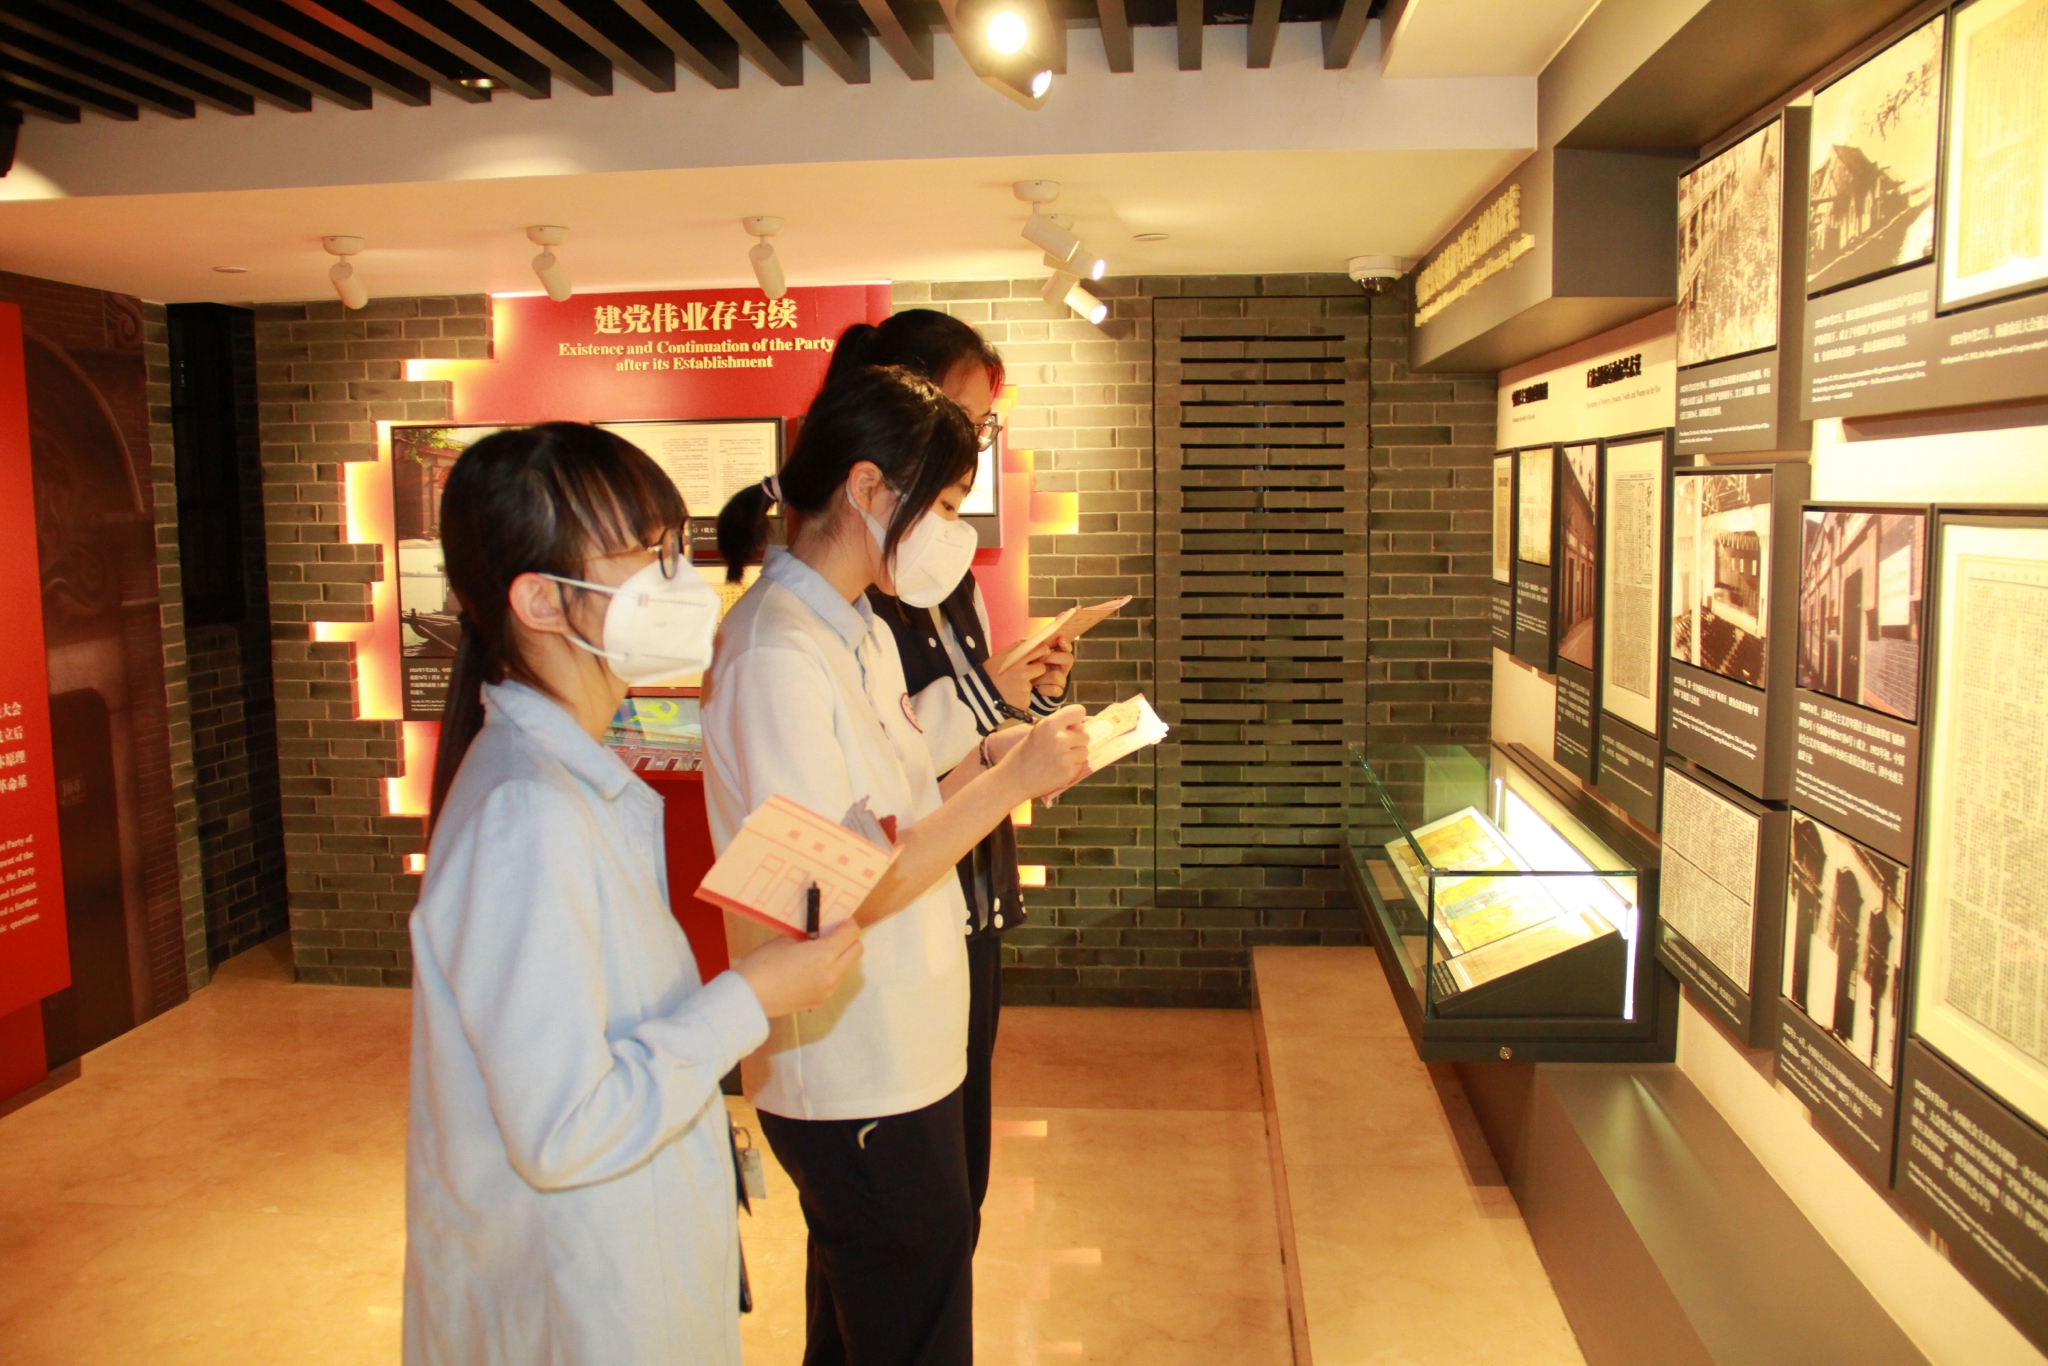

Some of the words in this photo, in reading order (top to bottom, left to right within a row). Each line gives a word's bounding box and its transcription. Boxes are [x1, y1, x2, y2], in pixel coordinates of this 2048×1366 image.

[594, 298, 797, 335] 建党伟业存与续
[559, 343, 624, 356] Existence
[627, 341, 653, 355] and
[657, 340, 749, 354] Continuation
[752, 339, 769, 352] of
[770, 338, 793, 351] the
[794, 337, 834, 352] Party
[616, 358, 649, 372] after
[652, 357, 670, 370] its
[673, 355, 773, 371] Establishment
[0, 701, 22, 718] 大会
[6, 838, 24, 849] Party
[25, 834, 33, 843] of
[15, 853, 22, 862] of
[23, 851, 34, 860] the
[6, 873, 16, 882] the
[17, 867, 35, 878] Party
[15, 898, 38, 911] further
[10, 913, 39, 930] questions
